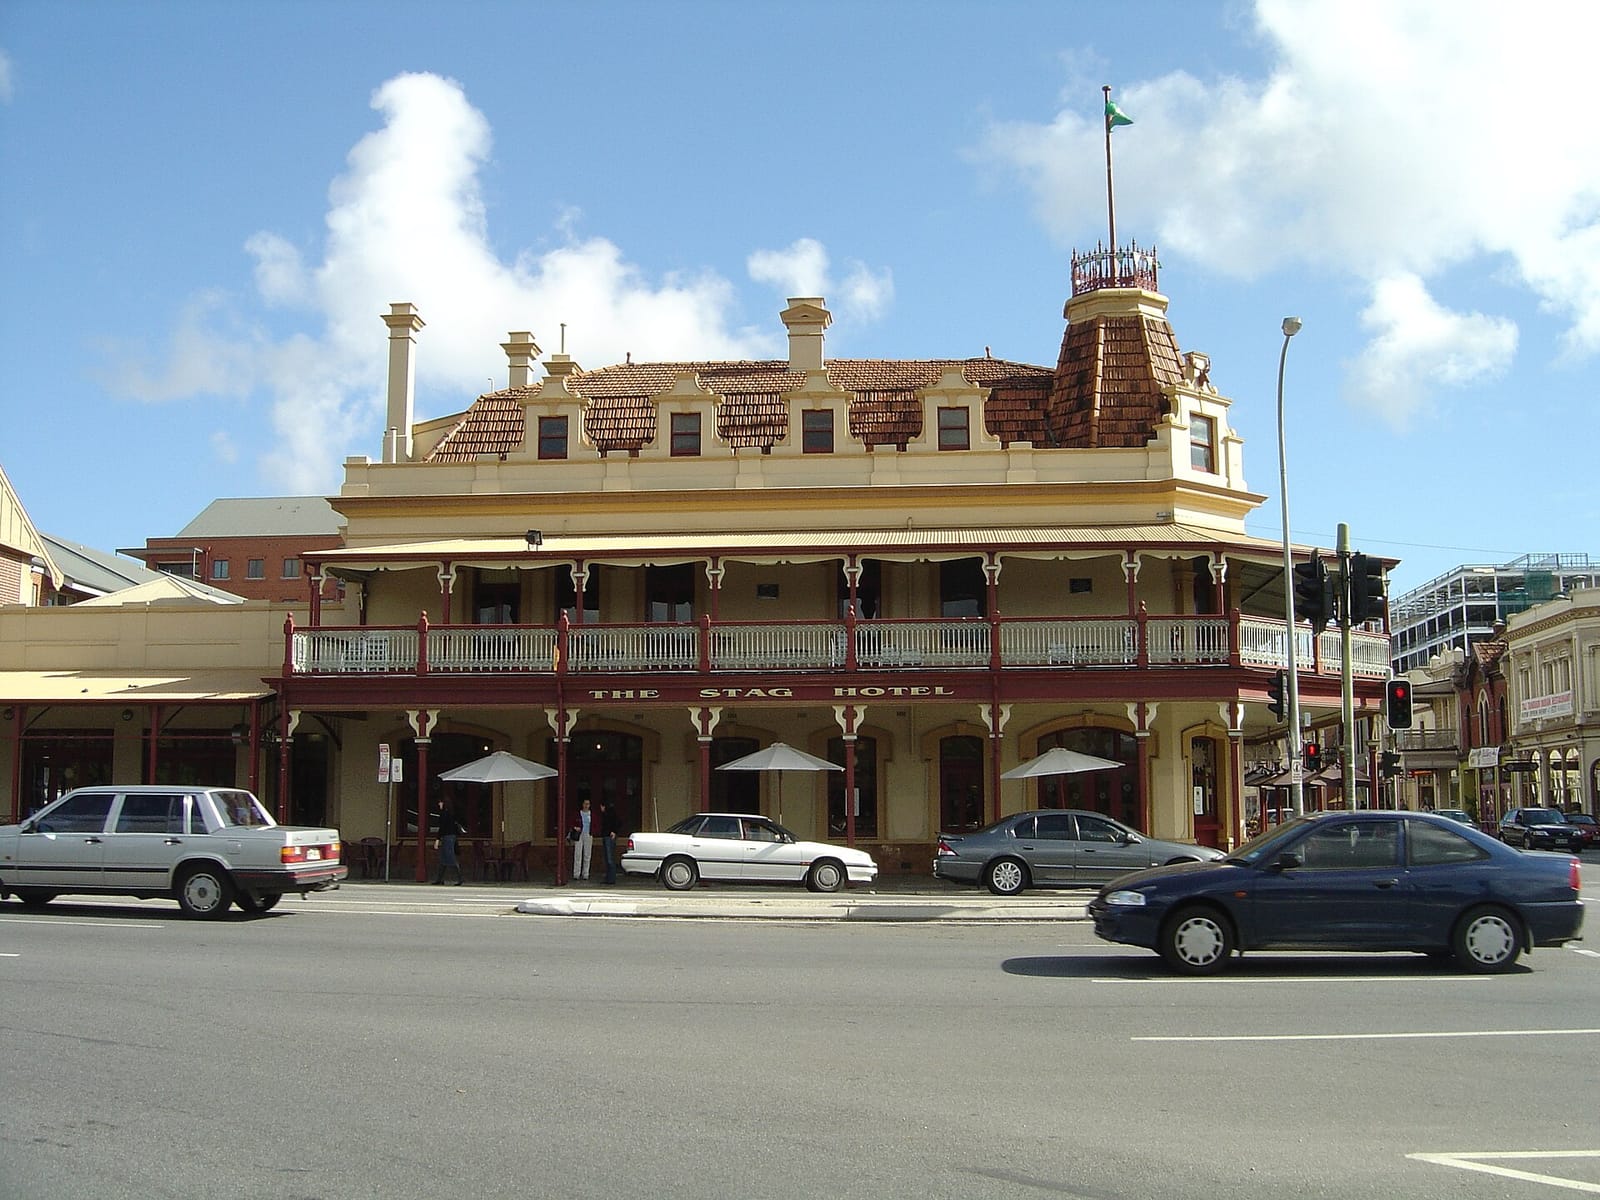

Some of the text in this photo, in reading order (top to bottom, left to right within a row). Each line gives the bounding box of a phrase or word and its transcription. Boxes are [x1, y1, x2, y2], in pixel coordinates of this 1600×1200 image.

[588, 686, 955, 699] THE STAG HOTEL
